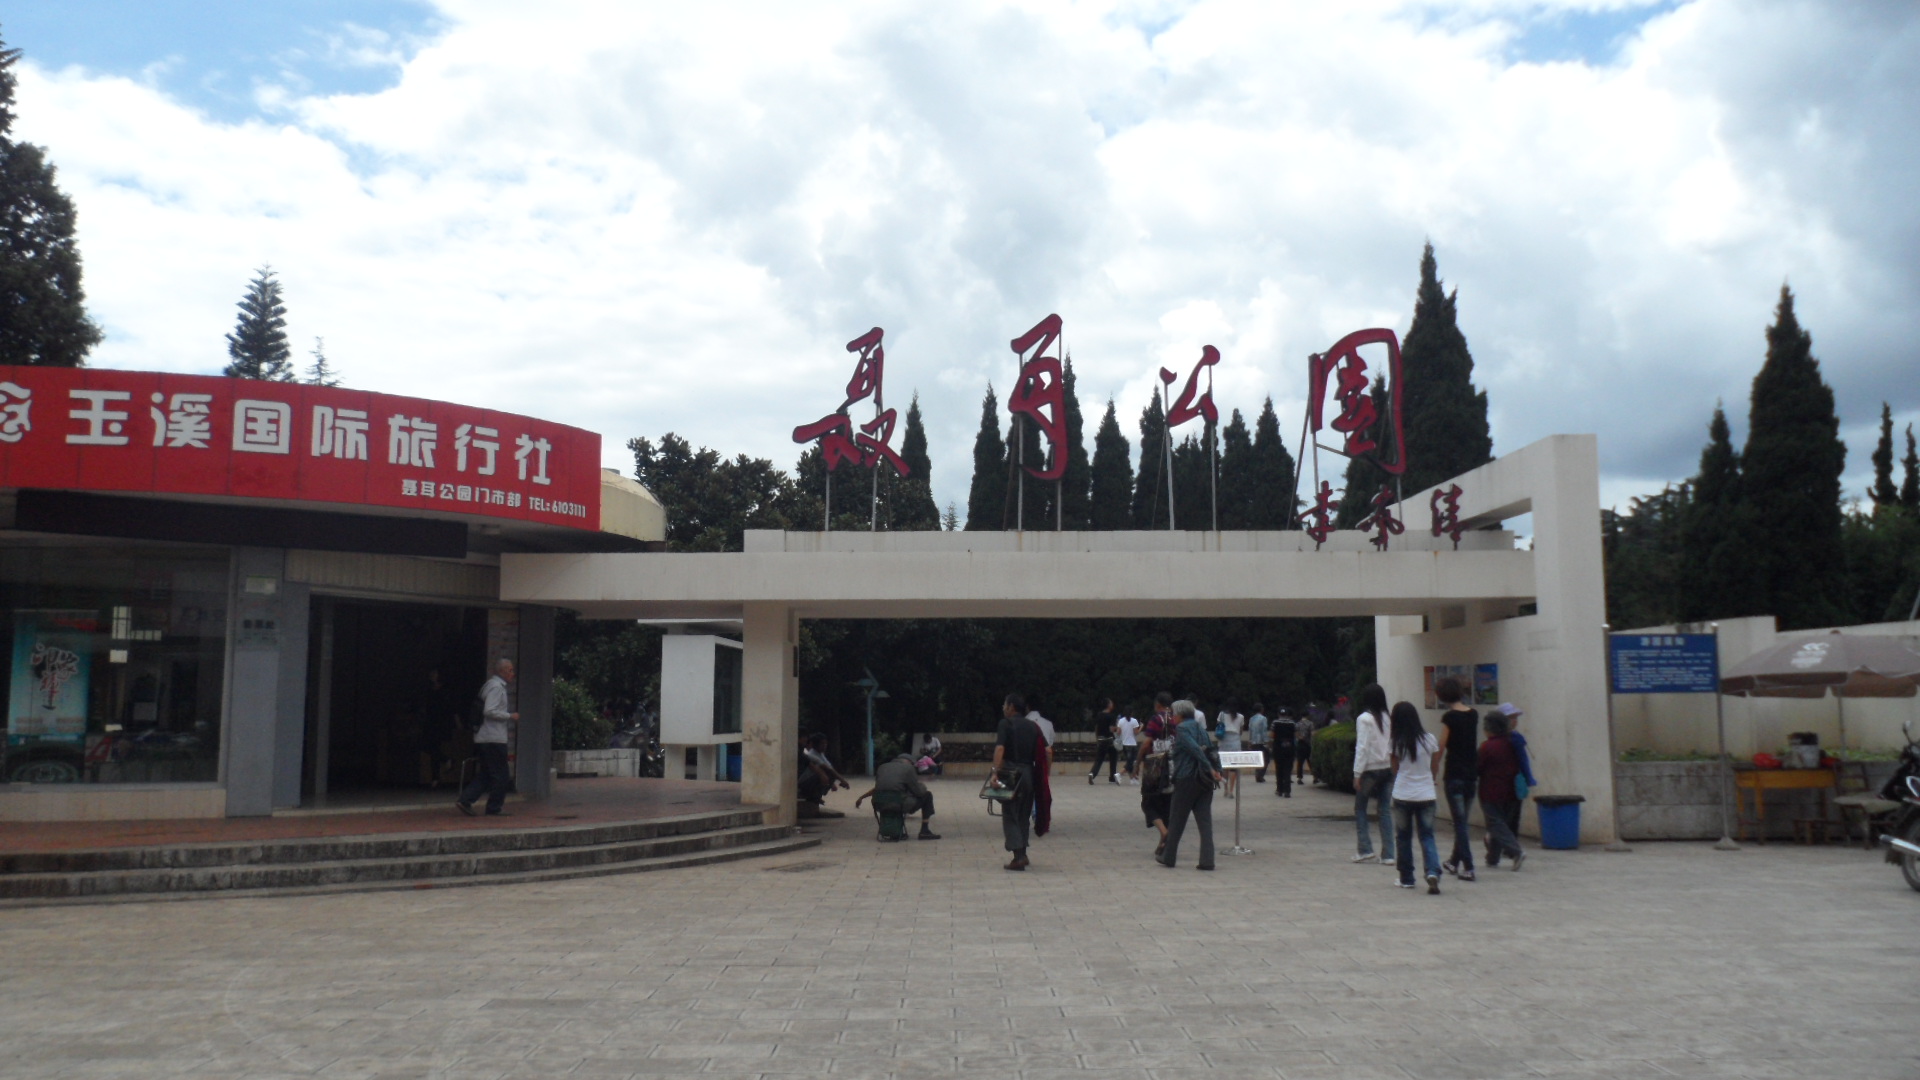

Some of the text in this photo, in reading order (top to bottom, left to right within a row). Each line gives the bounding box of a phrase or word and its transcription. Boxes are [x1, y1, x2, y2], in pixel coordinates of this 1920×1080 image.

[66, 389, 553, 486] 玉溪国际旅行社
[402, 478, 522, 509] 聂耳公园门市部
